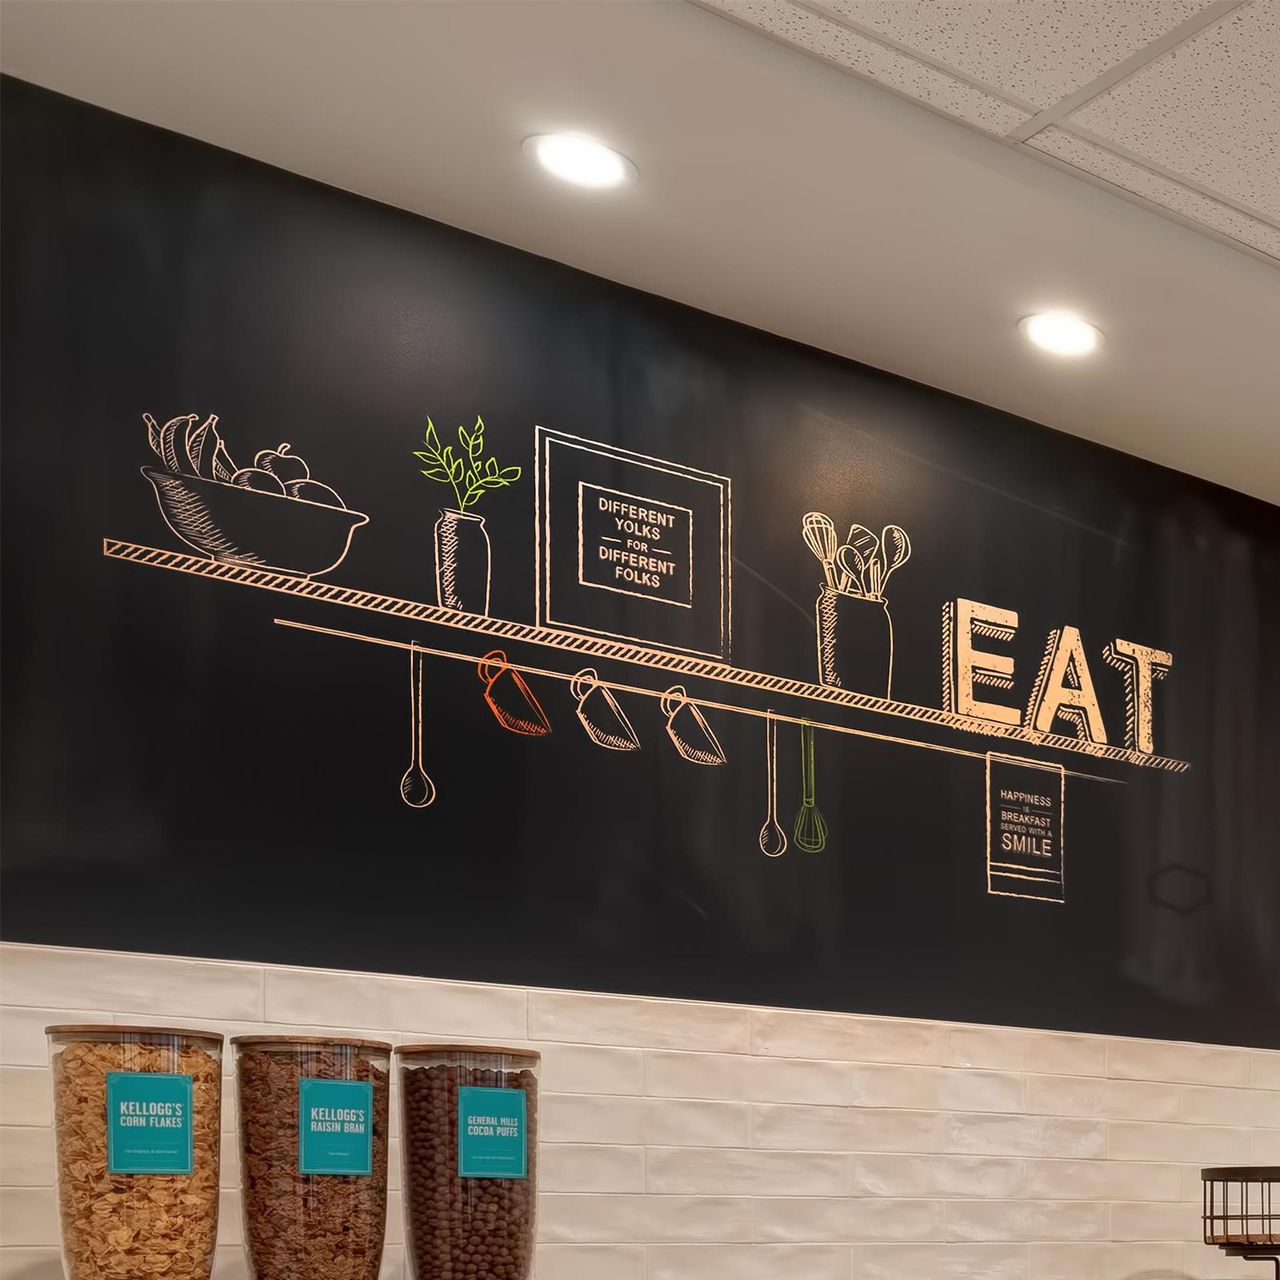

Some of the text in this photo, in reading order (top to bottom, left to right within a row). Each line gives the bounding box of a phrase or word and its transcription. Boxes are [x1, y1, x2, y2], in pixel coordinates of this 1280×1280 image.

[599, 497, 675, 528] DIFFERENT
[615, 517, 660, 540] YOLKS
[626, 539, 648, 553] FOR
[599, 545, 676, 576] DIFFERENT
[615, 566, 660, 588] FOLKS
[942, 598, 1173, 754] EAT
[1000, 789, 1052, 807] HAPPINESS
[1001, 810, 1051, 827] BREAKFAST
[1000, 822, 1053, 838] SERVED WITH A
[1002, 832, 1052, 857] SMILE
[120, 1101, 183, 1116] KELLOGG'S
[311, 1107, 365, 1122] KELLOGG'S
[120, 1116, 183, 1128] CORN FLAKES
[311, 1121, 365, 1134] RAISIN BRAN
[468, 1115, 518, 1127] GENERAL MILLS
[467, 1126, 518, 1137] COCOA PUFFS
